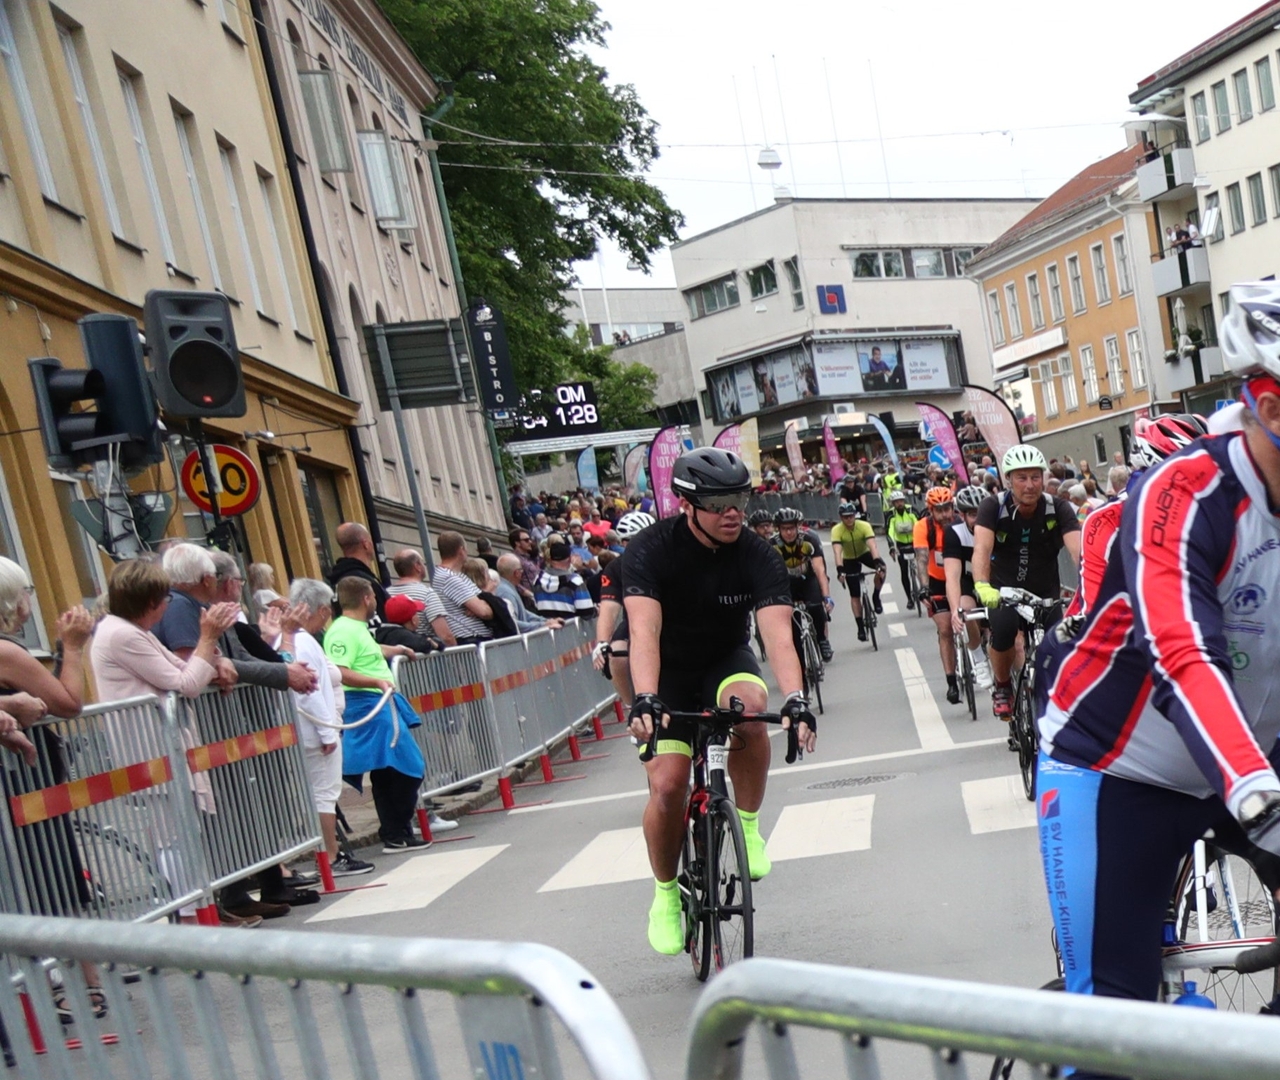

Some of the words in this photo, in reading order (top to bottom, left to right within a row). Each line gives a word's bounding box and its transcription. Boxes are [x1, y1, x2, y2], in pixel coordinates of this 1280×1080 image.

[483, 332, 505, 403] BISTRO
[556, 386, 586, 404] OM
[556, 404, 598, 425] 1:28
[1050, 821, 1063, 842] SV
[1052, 846, 1077, 971] HANSE-Klinikum
